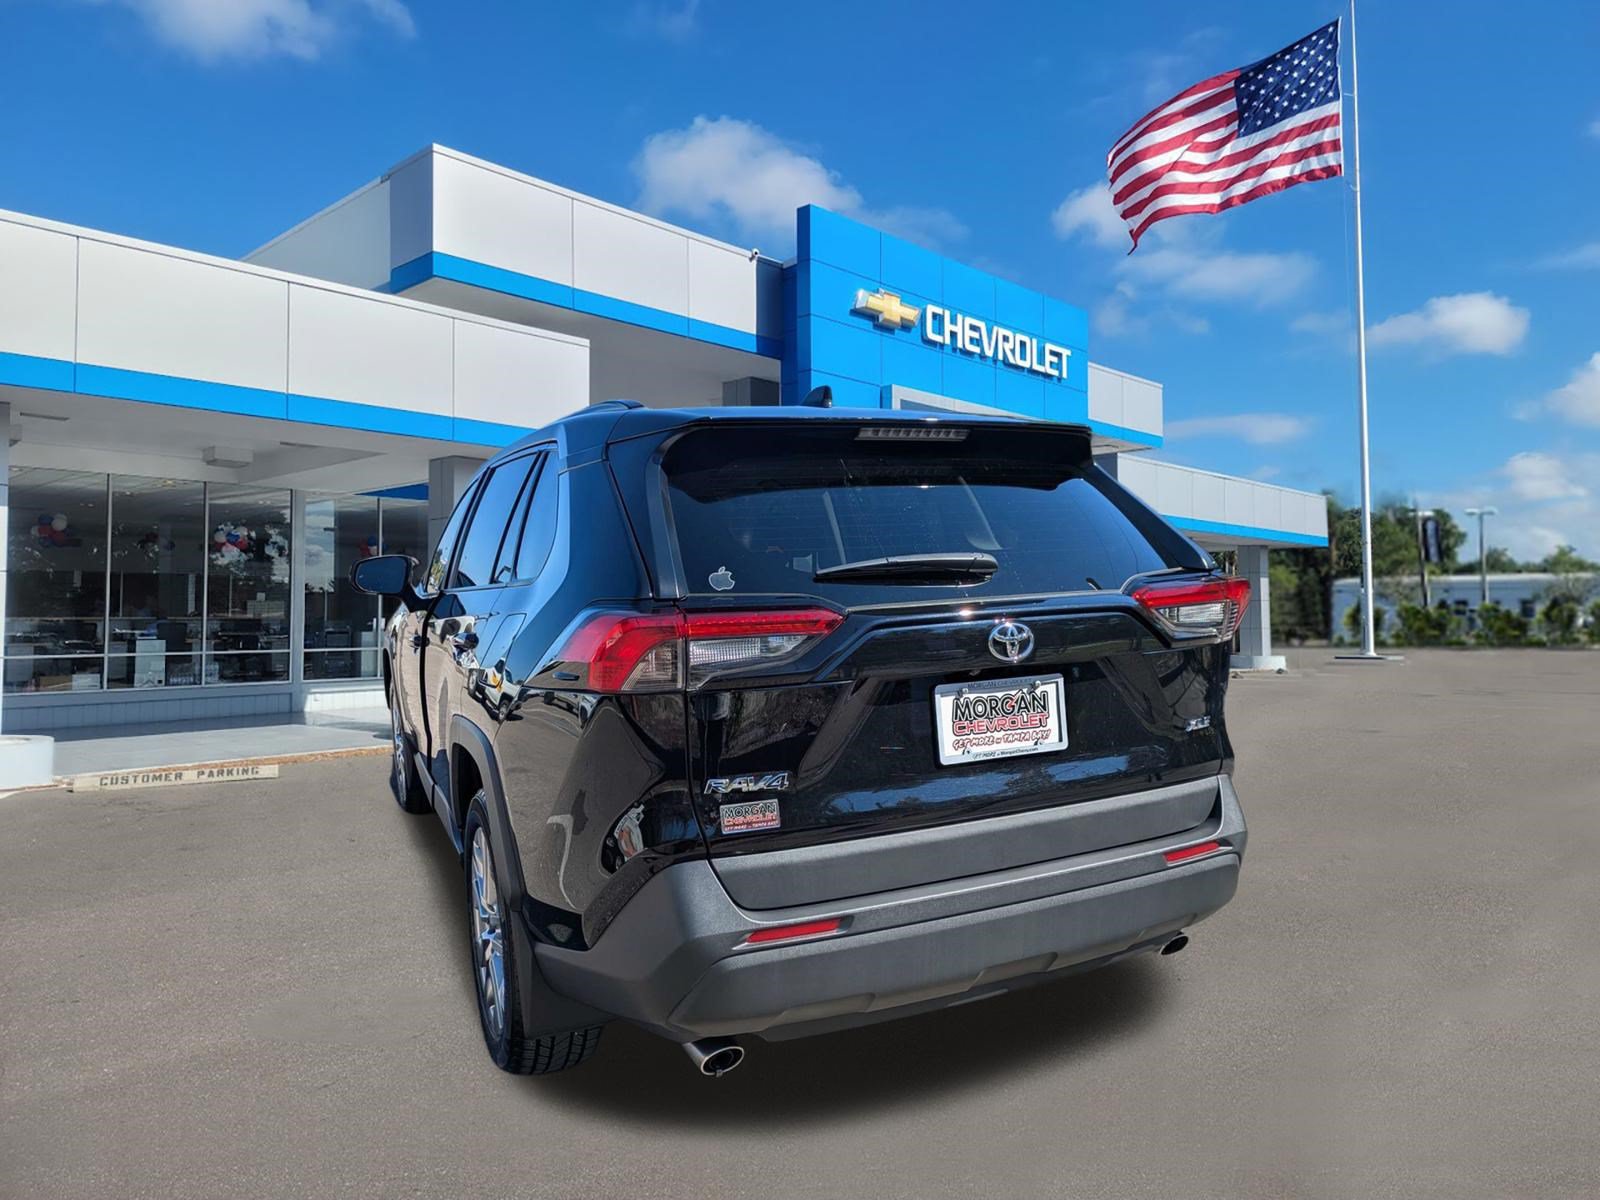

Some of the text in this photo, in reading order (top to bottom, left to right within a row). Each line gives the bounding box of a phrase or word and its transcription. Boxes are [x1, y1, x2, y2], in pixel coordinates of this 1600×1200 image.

[924, 303, 1072, 380] CHEVROLET
[952, 690, 1049, 722] MORGAN
[953, 713, 1049, 736] CHEVROLET
[971, 735, 995, 748] MORE
[1001, 731, 1031, 744] TAMPA
[99, 766, 259, 786] CUSTOMER PARKING
[703, 772, 789, 795] RAV4
[724, 802, 777, 818] MORGAN
